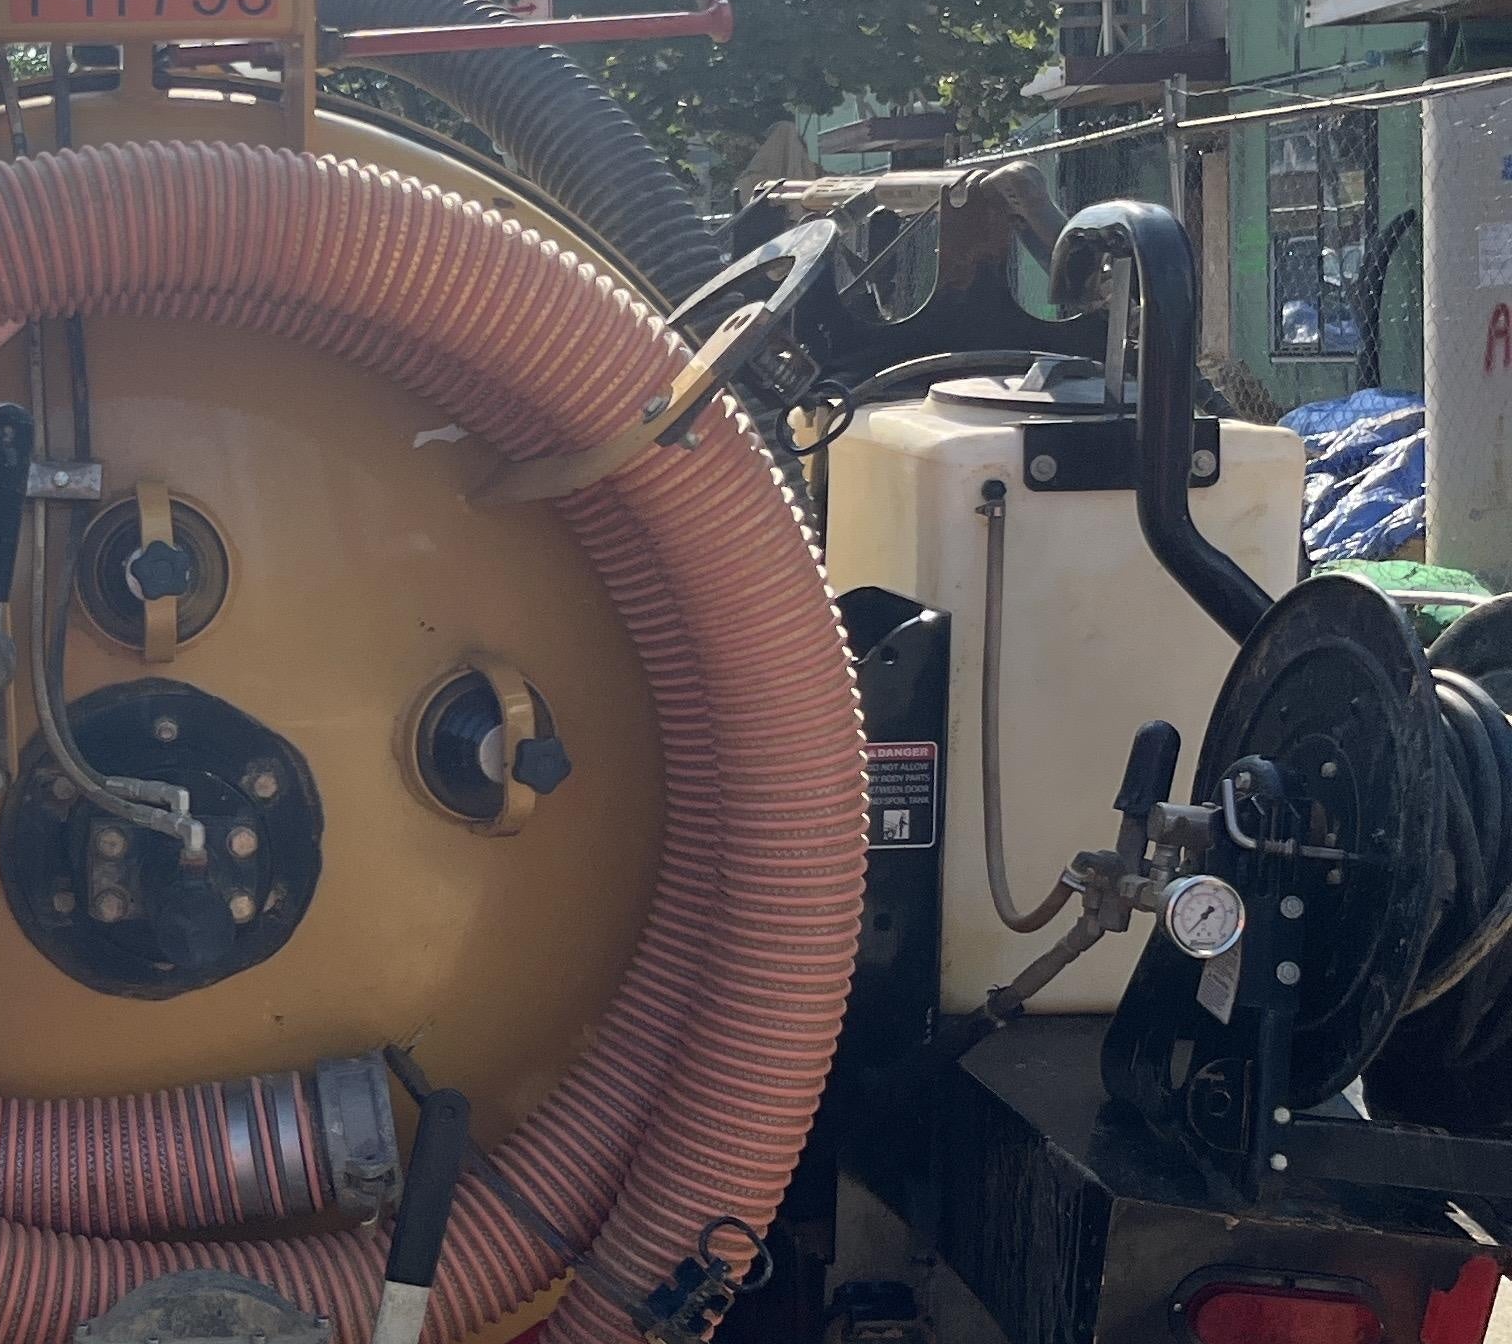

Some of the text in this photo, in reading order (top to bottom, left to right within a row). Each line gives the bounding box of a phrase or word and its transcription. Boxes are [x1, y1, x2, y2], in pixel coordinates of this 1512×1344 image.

[877, 747, 929, 758] DANGER
[901, 763, 929, 771] ALLOW
[881, 775, 904, 783] BODY
[905, 774, 930, 782] PARTS
[905, 785, 929, 793] DOOR
[884, 797, 907, 805] SPOIL
[909, 796, 929, 804] TANK
